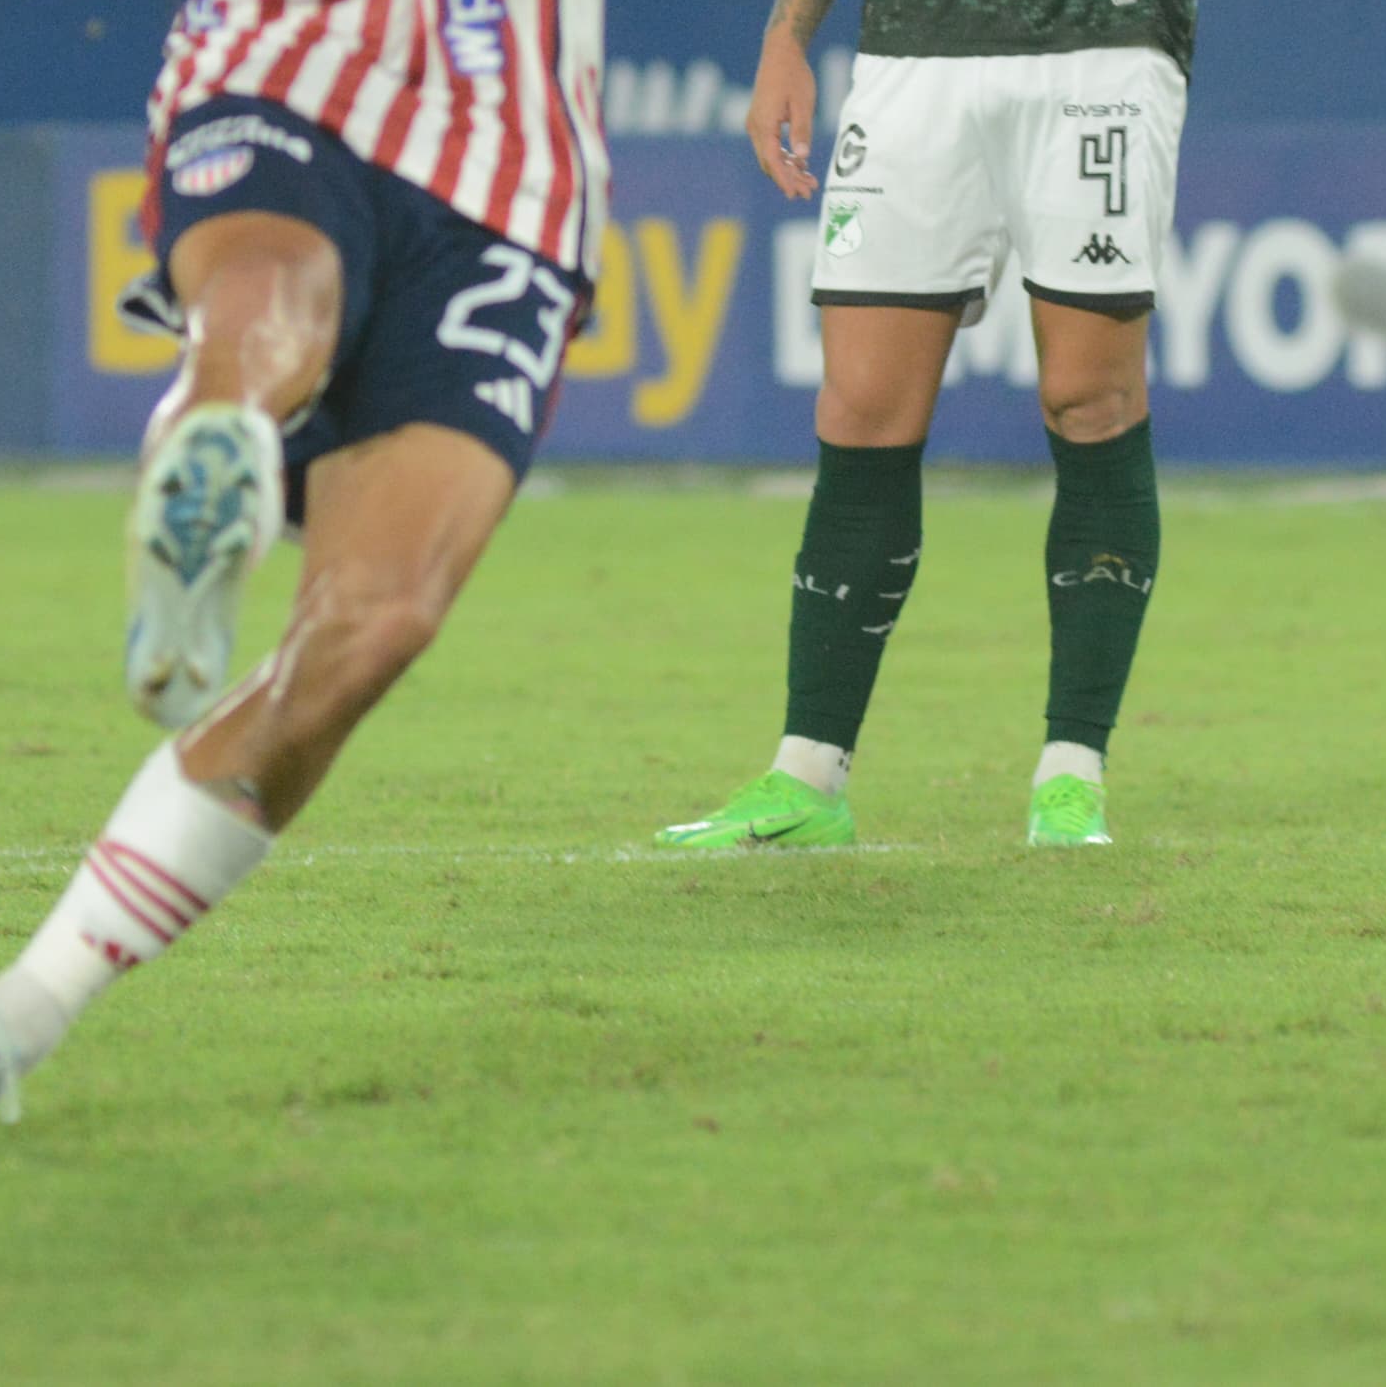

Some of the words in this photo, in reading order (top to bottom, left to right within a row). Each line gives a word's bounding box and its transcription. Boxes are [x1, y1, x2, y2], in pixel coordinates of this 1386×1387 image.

[1079, 125, 1128, 216] 4
[436, 244, 574, 390] 23
[1052, 566, 1152, 596] CALI
